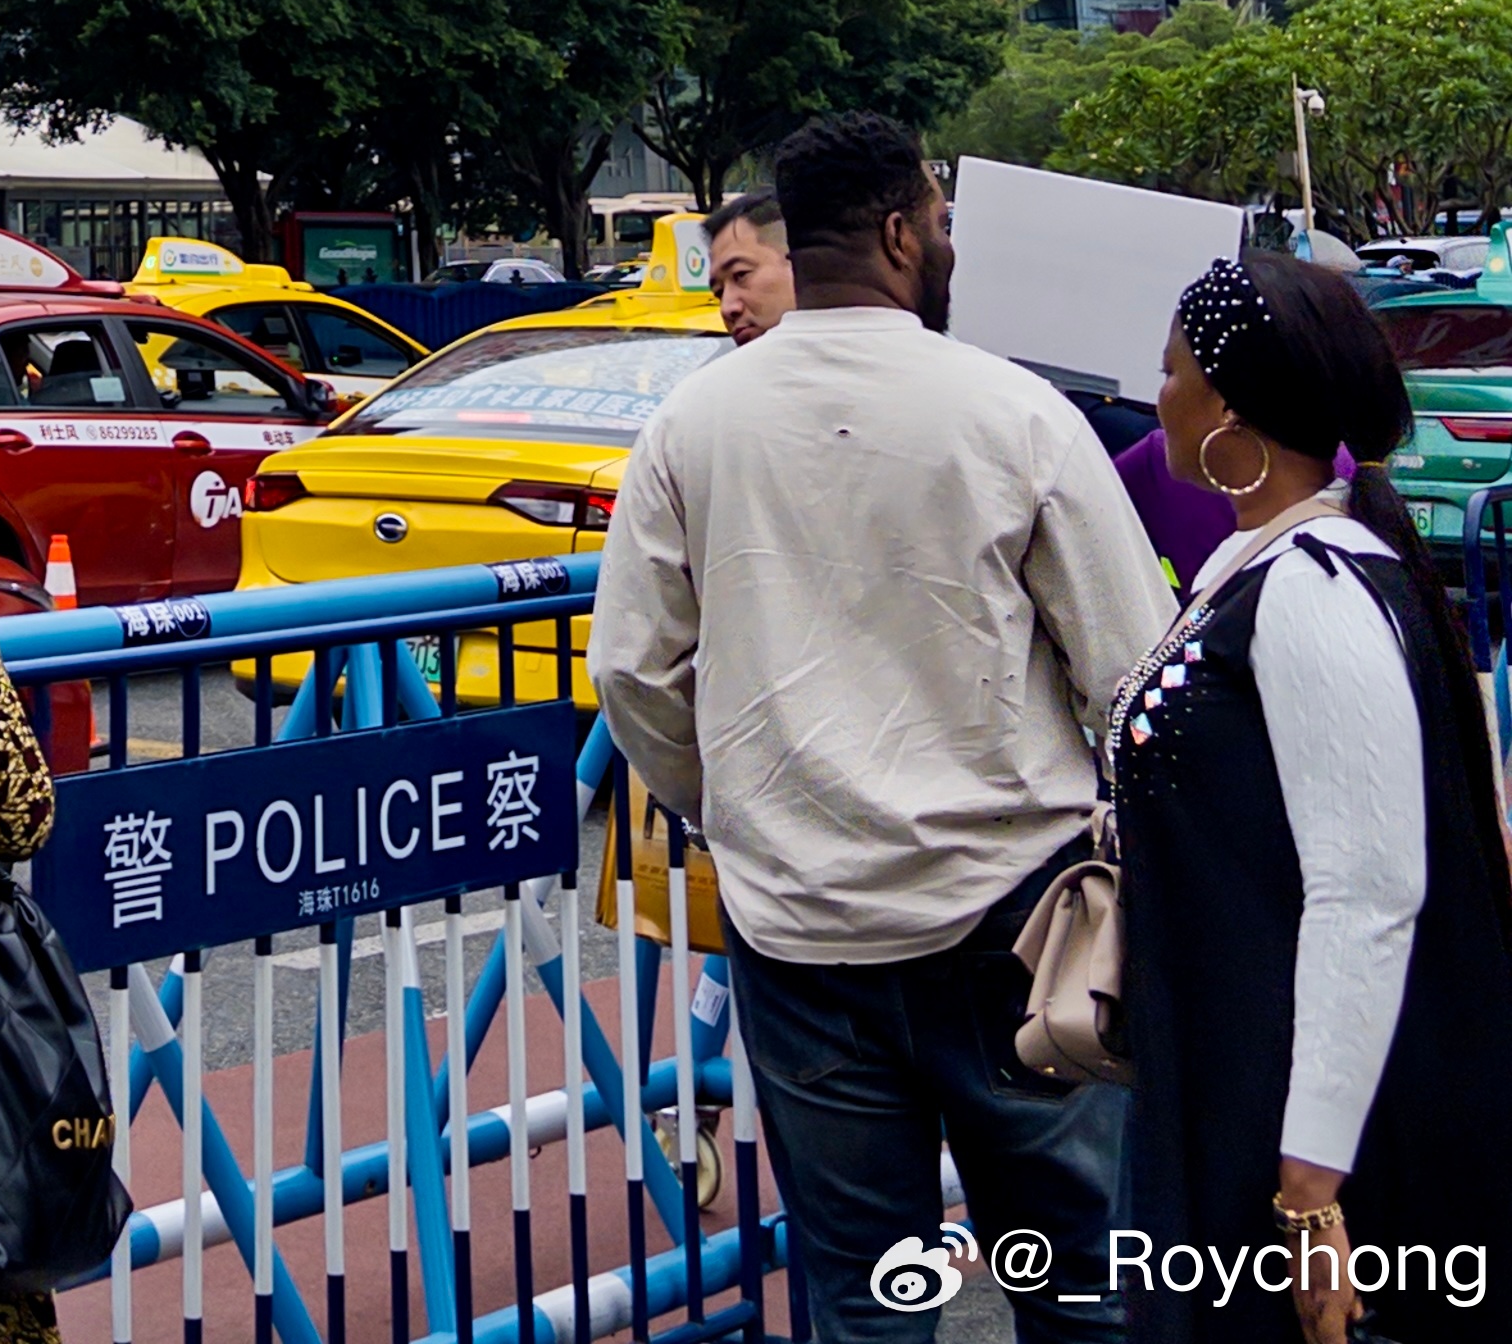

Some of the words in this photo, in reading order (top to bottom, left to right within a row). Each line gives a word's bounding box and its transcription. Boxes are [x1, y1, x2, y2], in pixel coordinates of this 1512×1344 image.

[39, 423, 80, 441] 利士风
[99, 425, 159, 441] 86299285
[262, 429, 296, 445] 电动车
[198, 476, 244, 524] TA
[104, 810, 173, 928] 警
[206, 770, 466, 896] POLICE
[486, 750, 541, 851] 察
[298, 877, 380, 917] 海珠T1616
[52, 1113, 116, 1150] CHA
